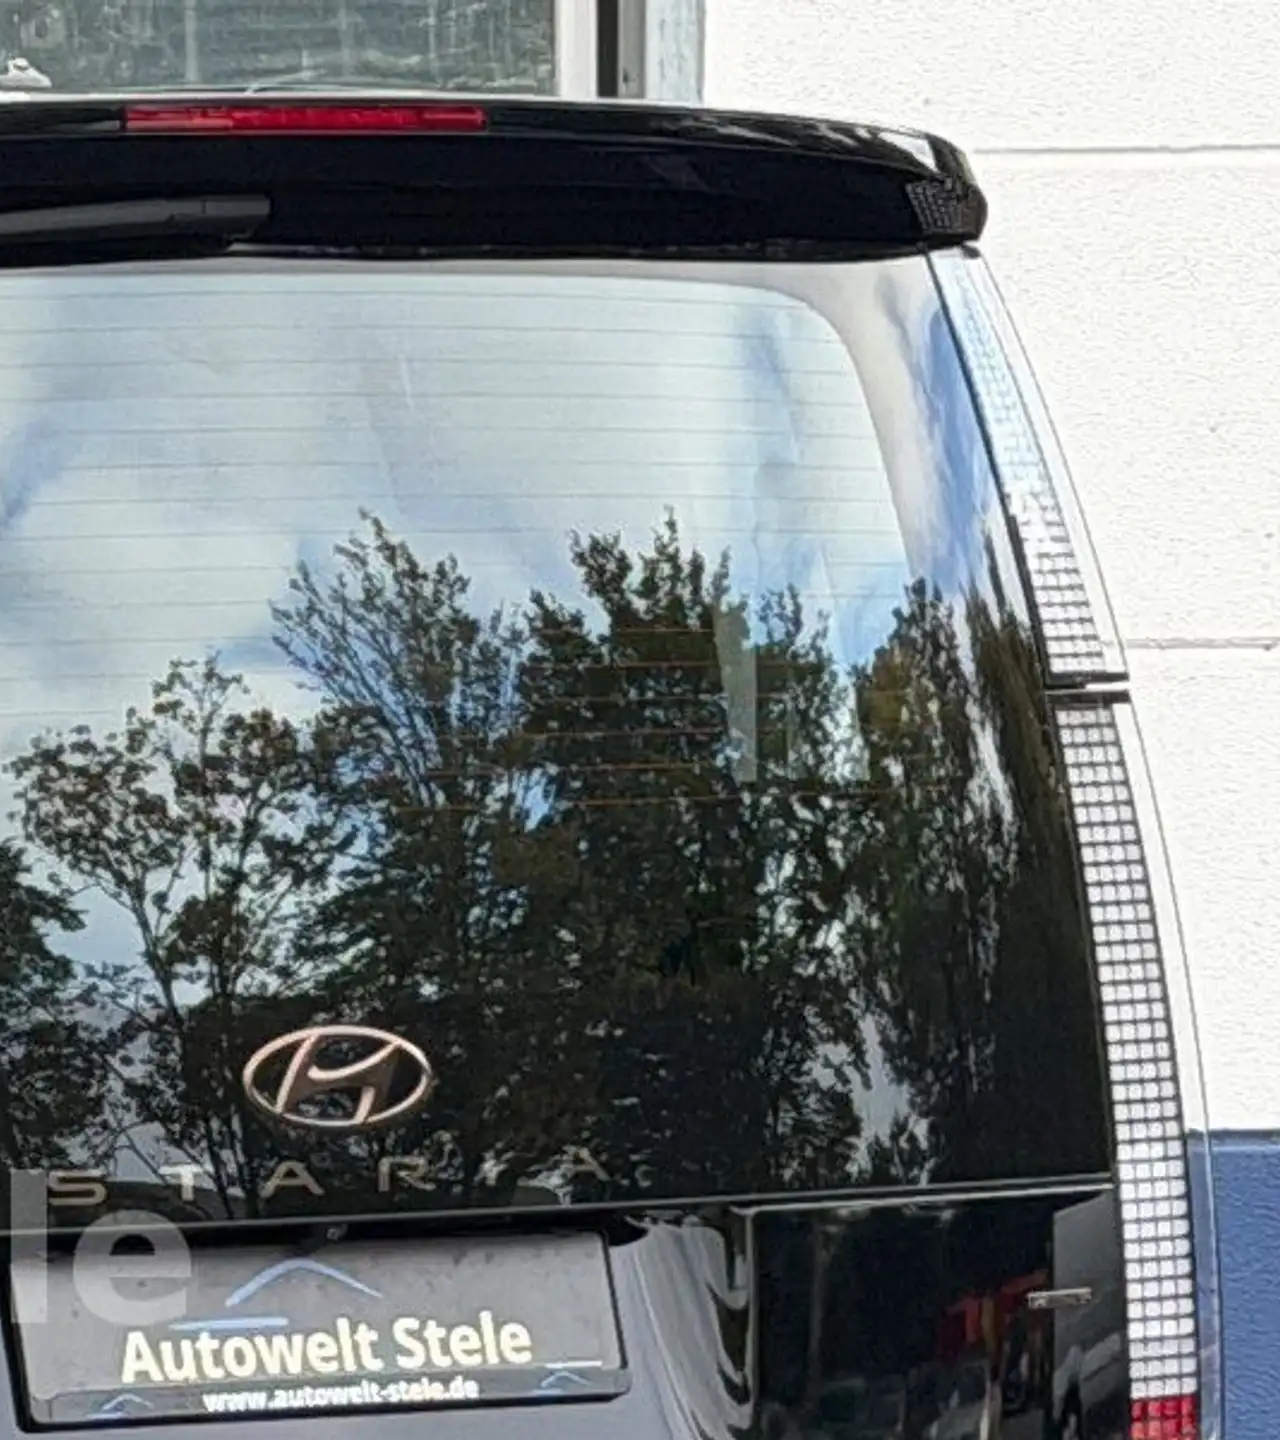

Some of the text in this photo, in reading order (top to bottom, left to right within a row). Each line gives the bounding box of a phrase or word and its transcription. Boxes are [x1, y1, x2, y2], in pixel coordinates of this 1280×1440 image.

[121, 1310, 533, 1384] Autowelt Stele
[202, 1376, 481, 1413] www.autowelt-stele.de
